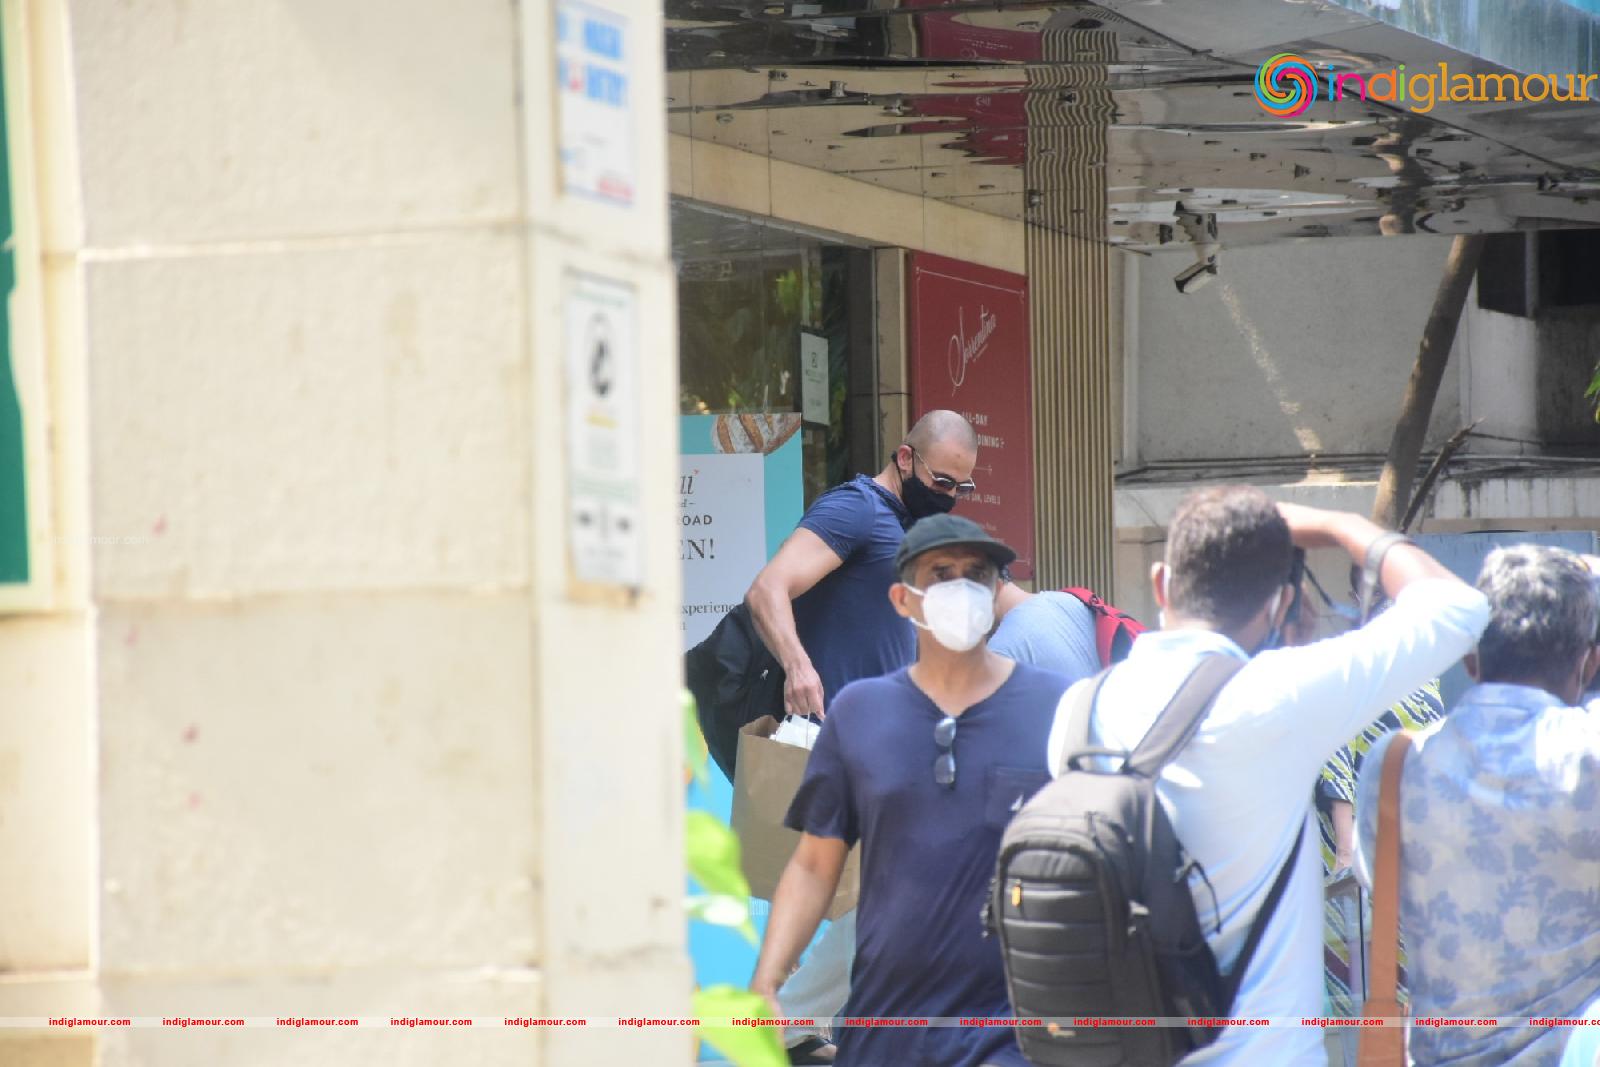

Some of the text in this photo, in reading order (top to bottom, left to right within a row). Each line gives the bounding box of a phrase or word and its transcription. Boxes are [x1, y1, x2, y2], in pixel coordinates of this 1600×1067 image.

[680, 475, 694, 494] ll
[681, 514, 713, 526] OAD
[682, 601, 736, 616] xperienc
